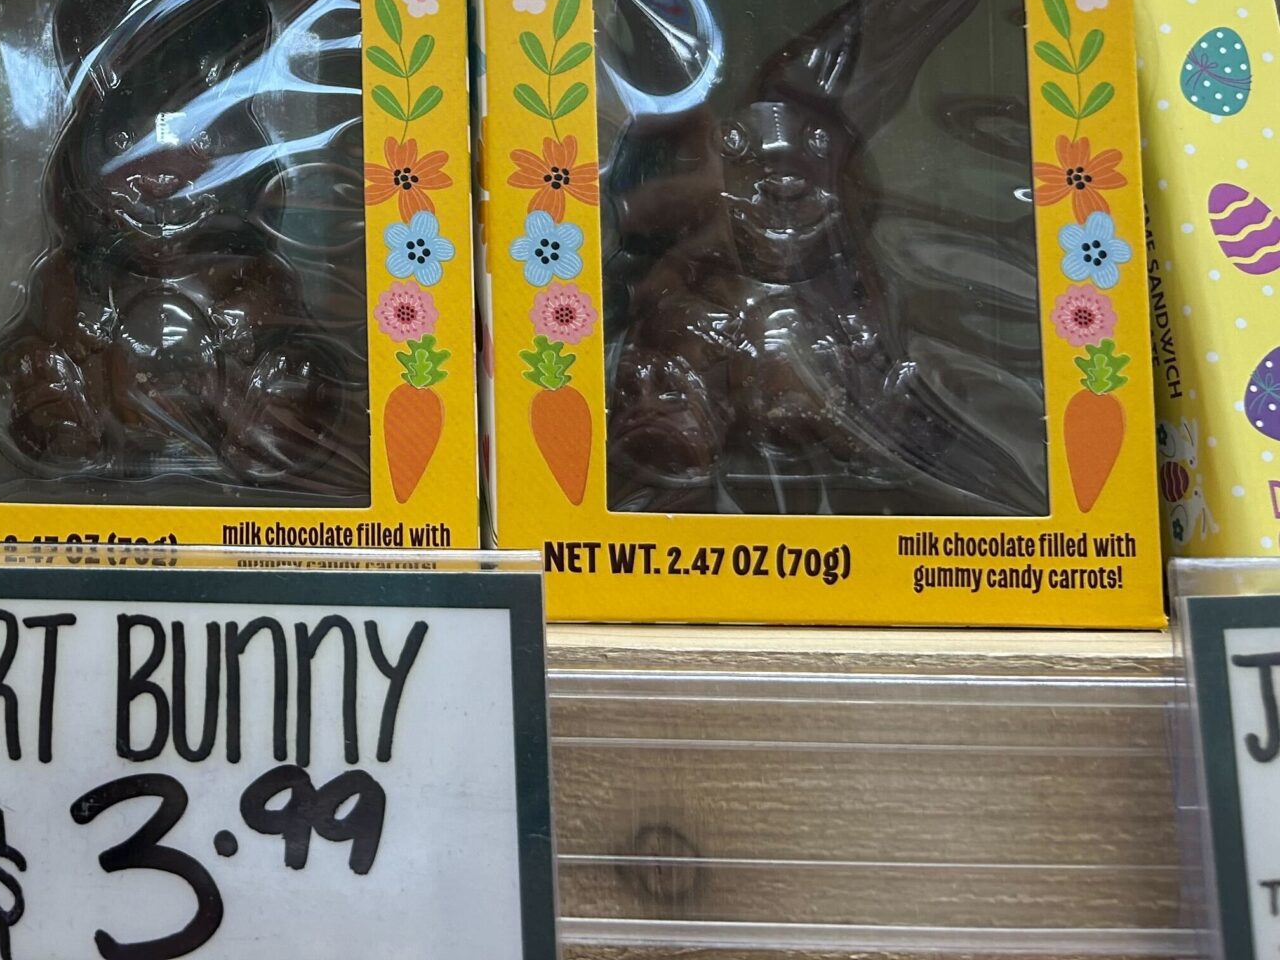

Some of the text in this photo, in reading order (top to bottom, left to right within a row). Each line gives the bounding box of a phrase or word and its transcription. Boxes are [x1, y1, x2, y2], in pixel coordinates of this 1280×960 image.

[1148, 259, 1182, 399] SANDWICH
[222, 521, 450, 547] milk chocolate filled with
[899, 532, 1136, 557] milk chocolate filled with
[545, 542, 850, 585] NET WT. 2.47 OZ (70g)
[914, 564, 1123, 594] gummy candy carrots!
